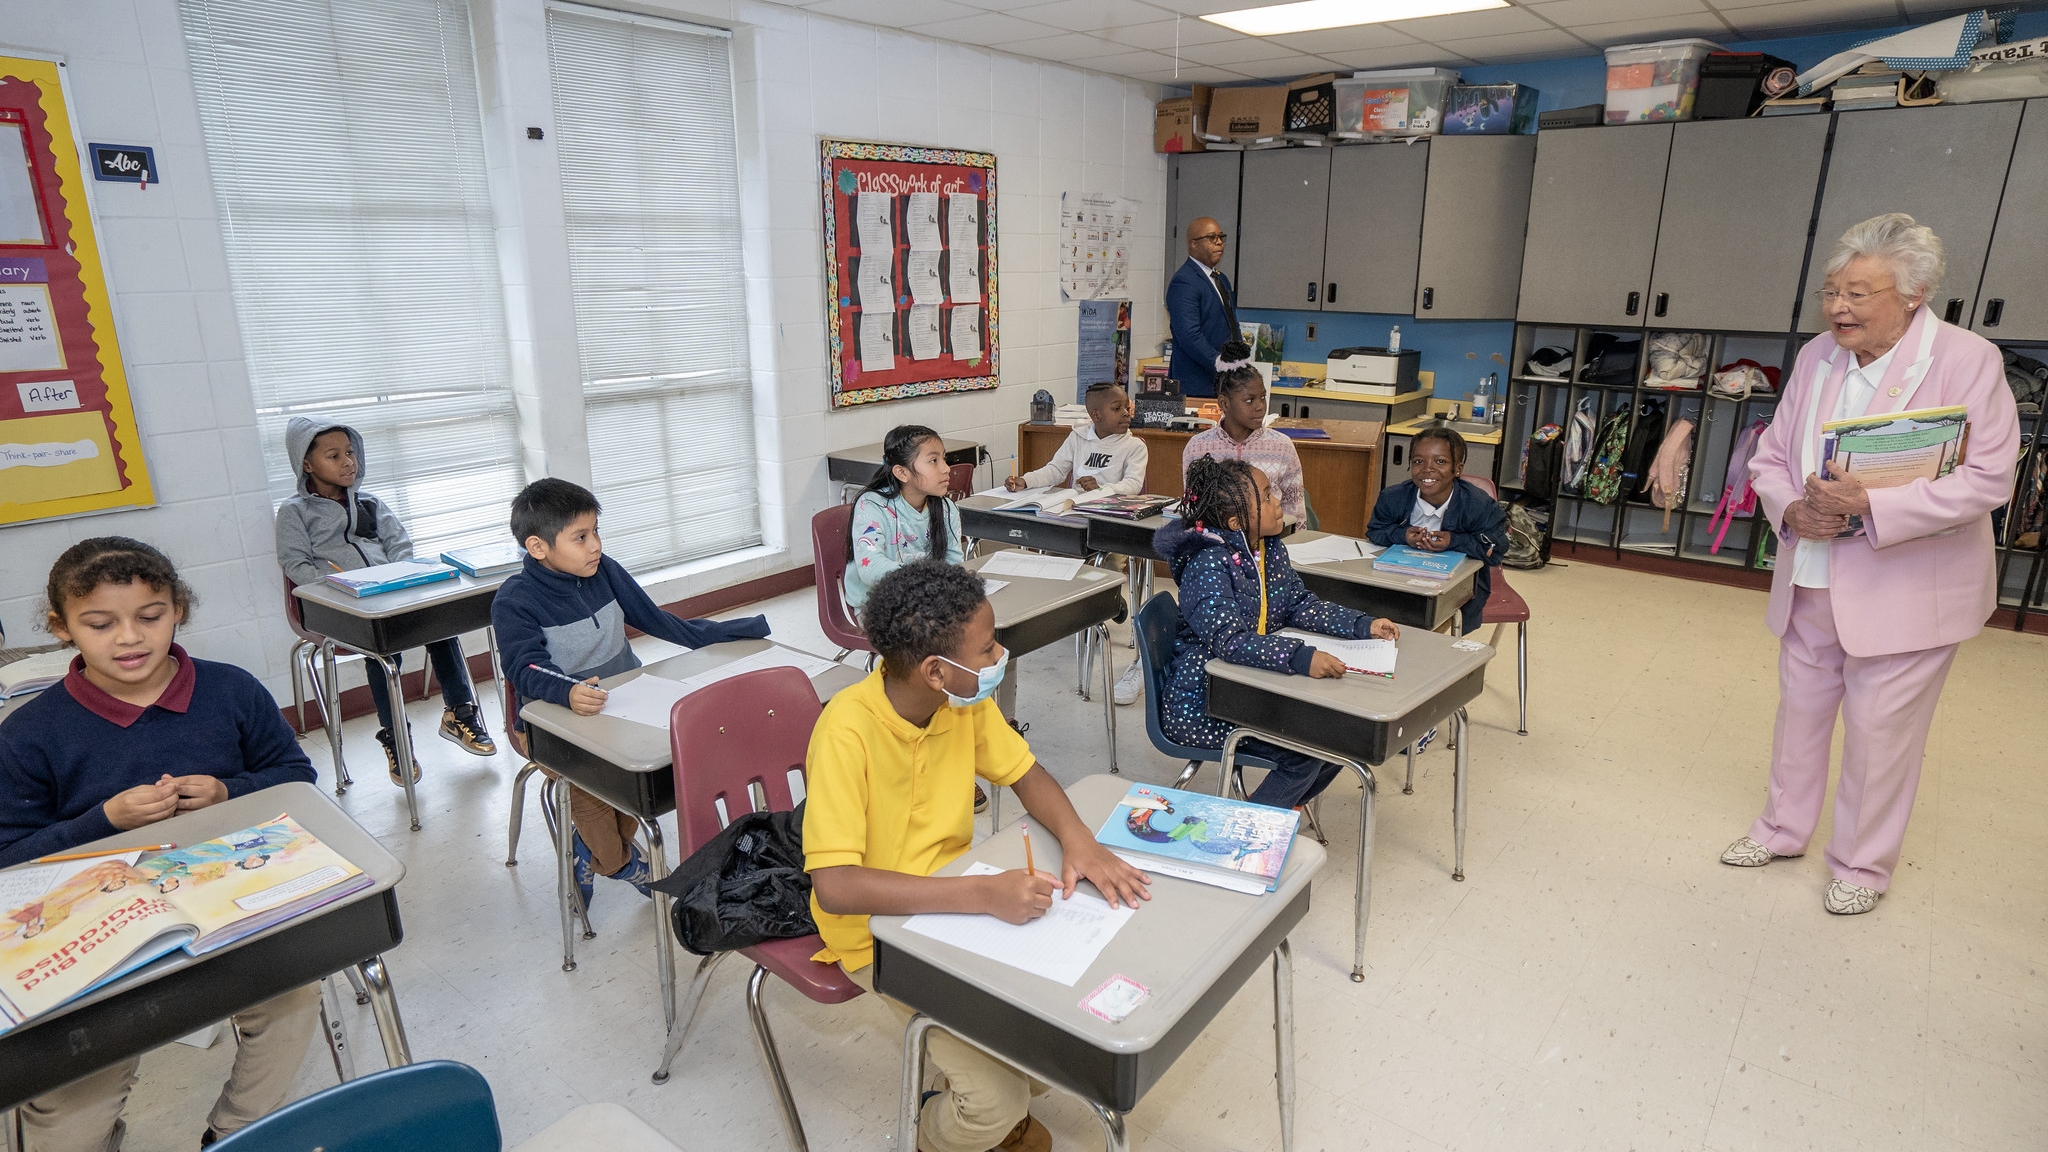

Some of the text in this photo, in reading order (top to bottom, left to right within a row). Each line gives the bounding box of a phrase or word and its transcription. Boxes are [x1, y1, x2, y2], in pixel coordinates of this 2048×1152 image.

[1425, 121, 1431, 129] 3
[104, 152, 141, 172] Abc
[930, 174, 942, 194] of
[943, 177, 965, 195] art
[0, 267, 30, 281] ary
[29, 386, 73, 402] After
[1143, 411, 1175, 419] TEACHER
[1084, 452, 1113, 468] NIKE
[79, 903, 177, 954] Dancing
[23, 956, 78, 991] Bird
